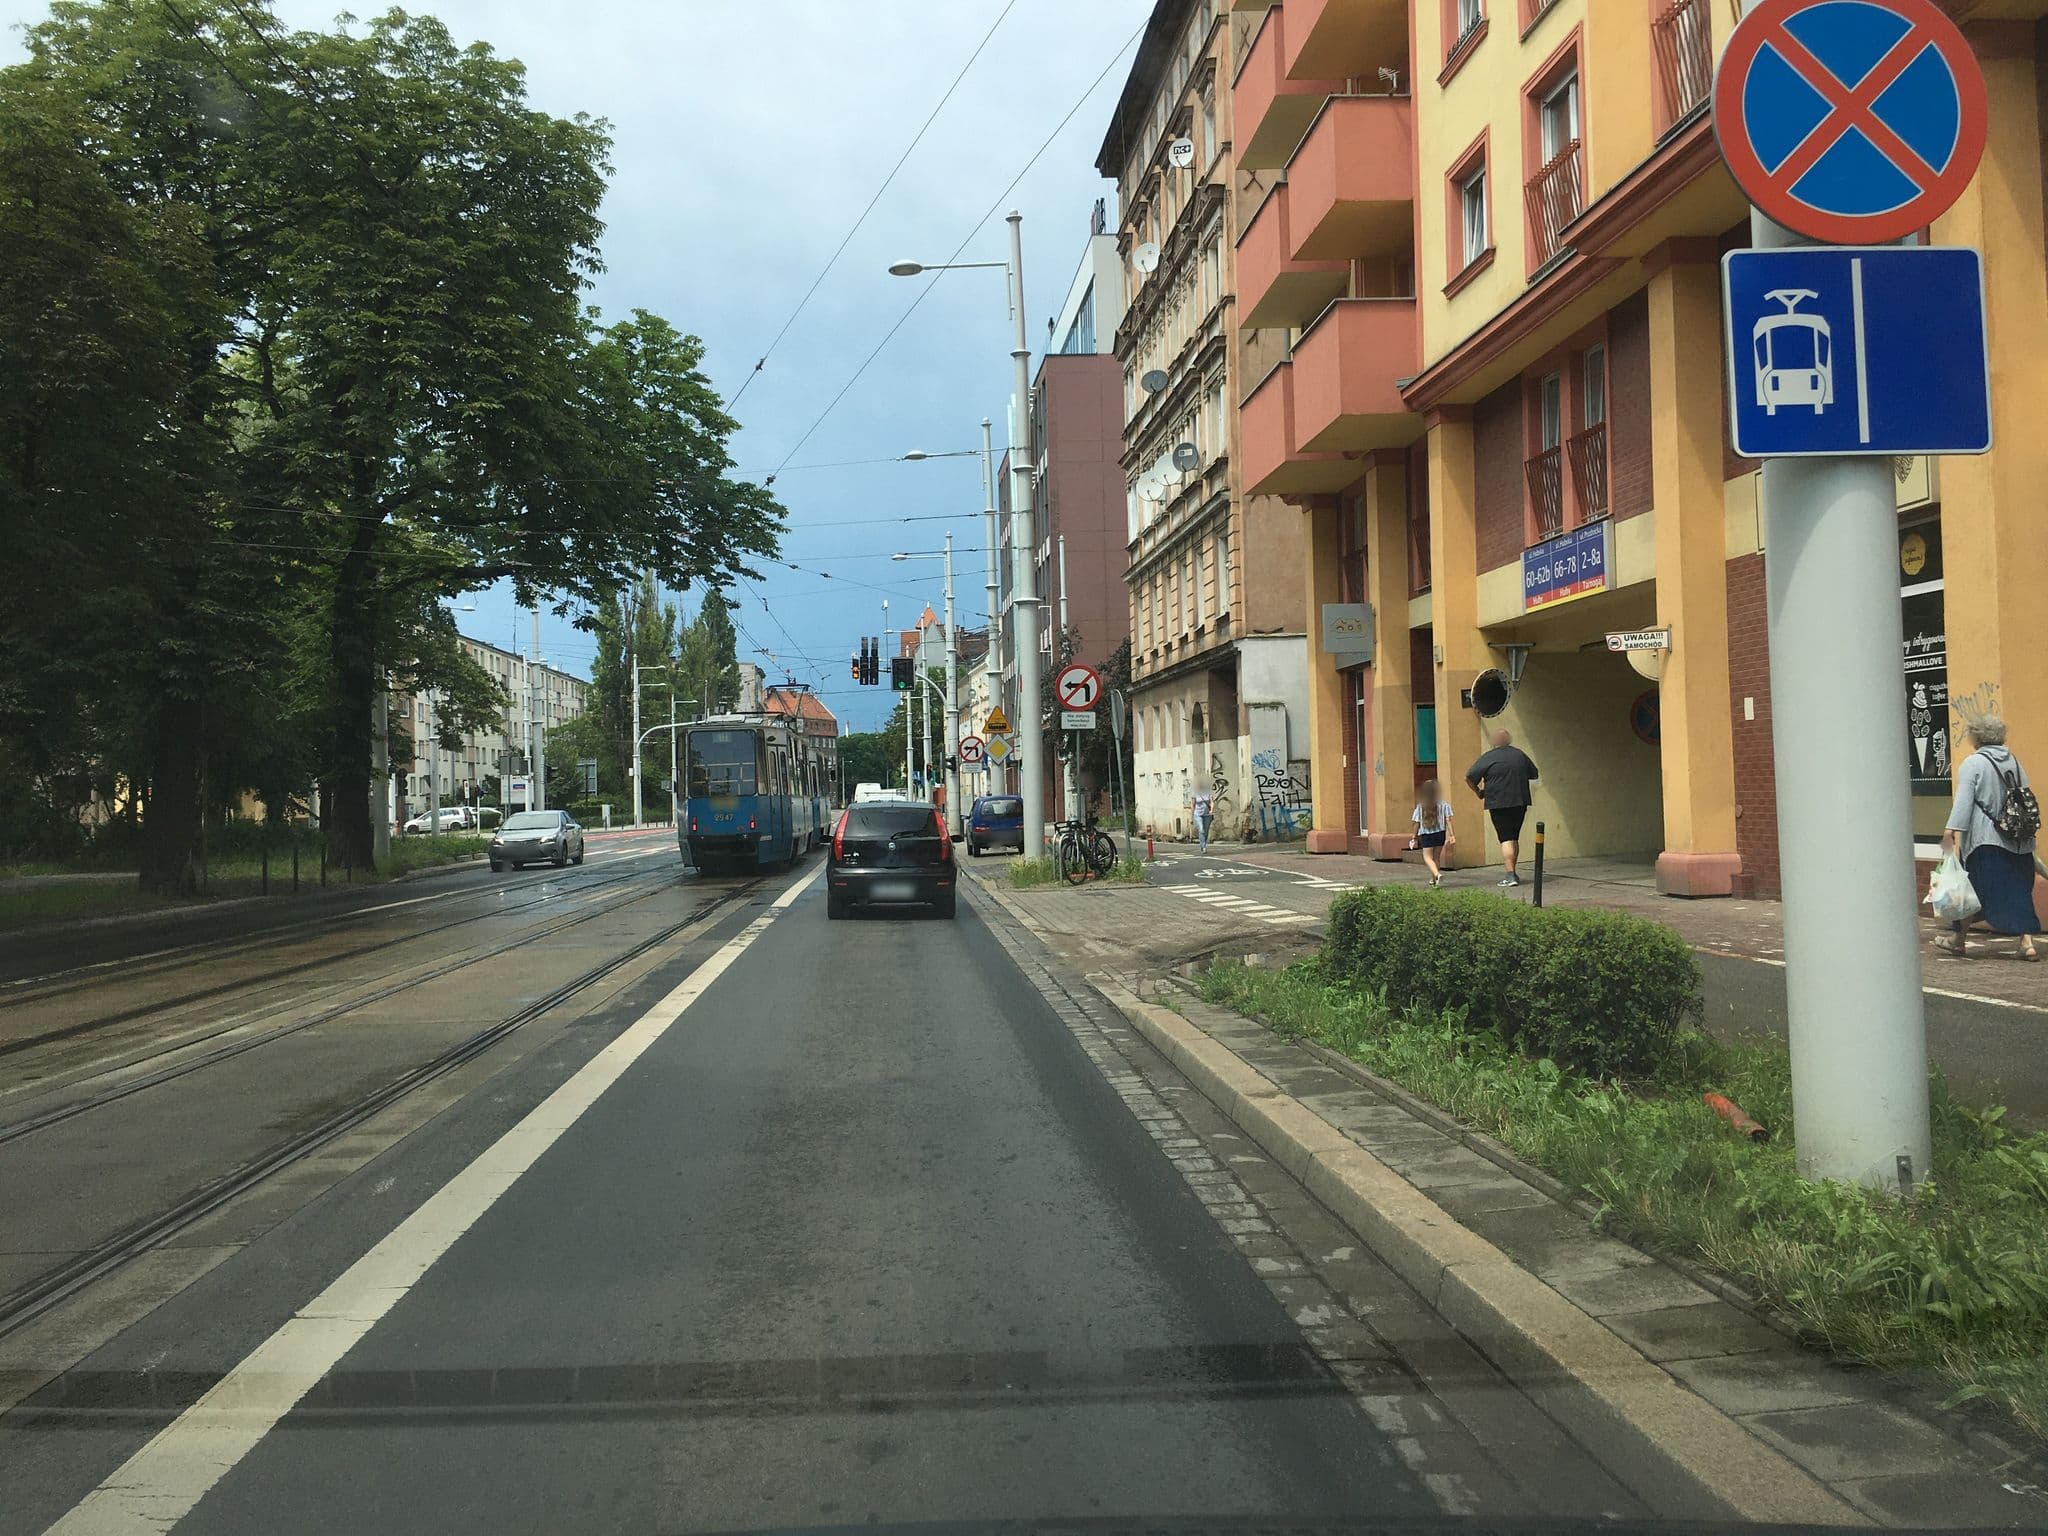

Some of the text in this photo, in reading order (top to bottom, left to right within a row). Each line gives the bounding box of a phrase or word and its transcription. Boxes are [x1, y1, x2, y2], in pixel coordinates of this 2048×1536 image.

[1554, 555, 1577, 579] 66-78
[1582, 547, 1602, 570] 2-8a
[1526, 565, 1552, 589] 60-62b
[1624, 632, 1664, 641] UWAGA!!!
